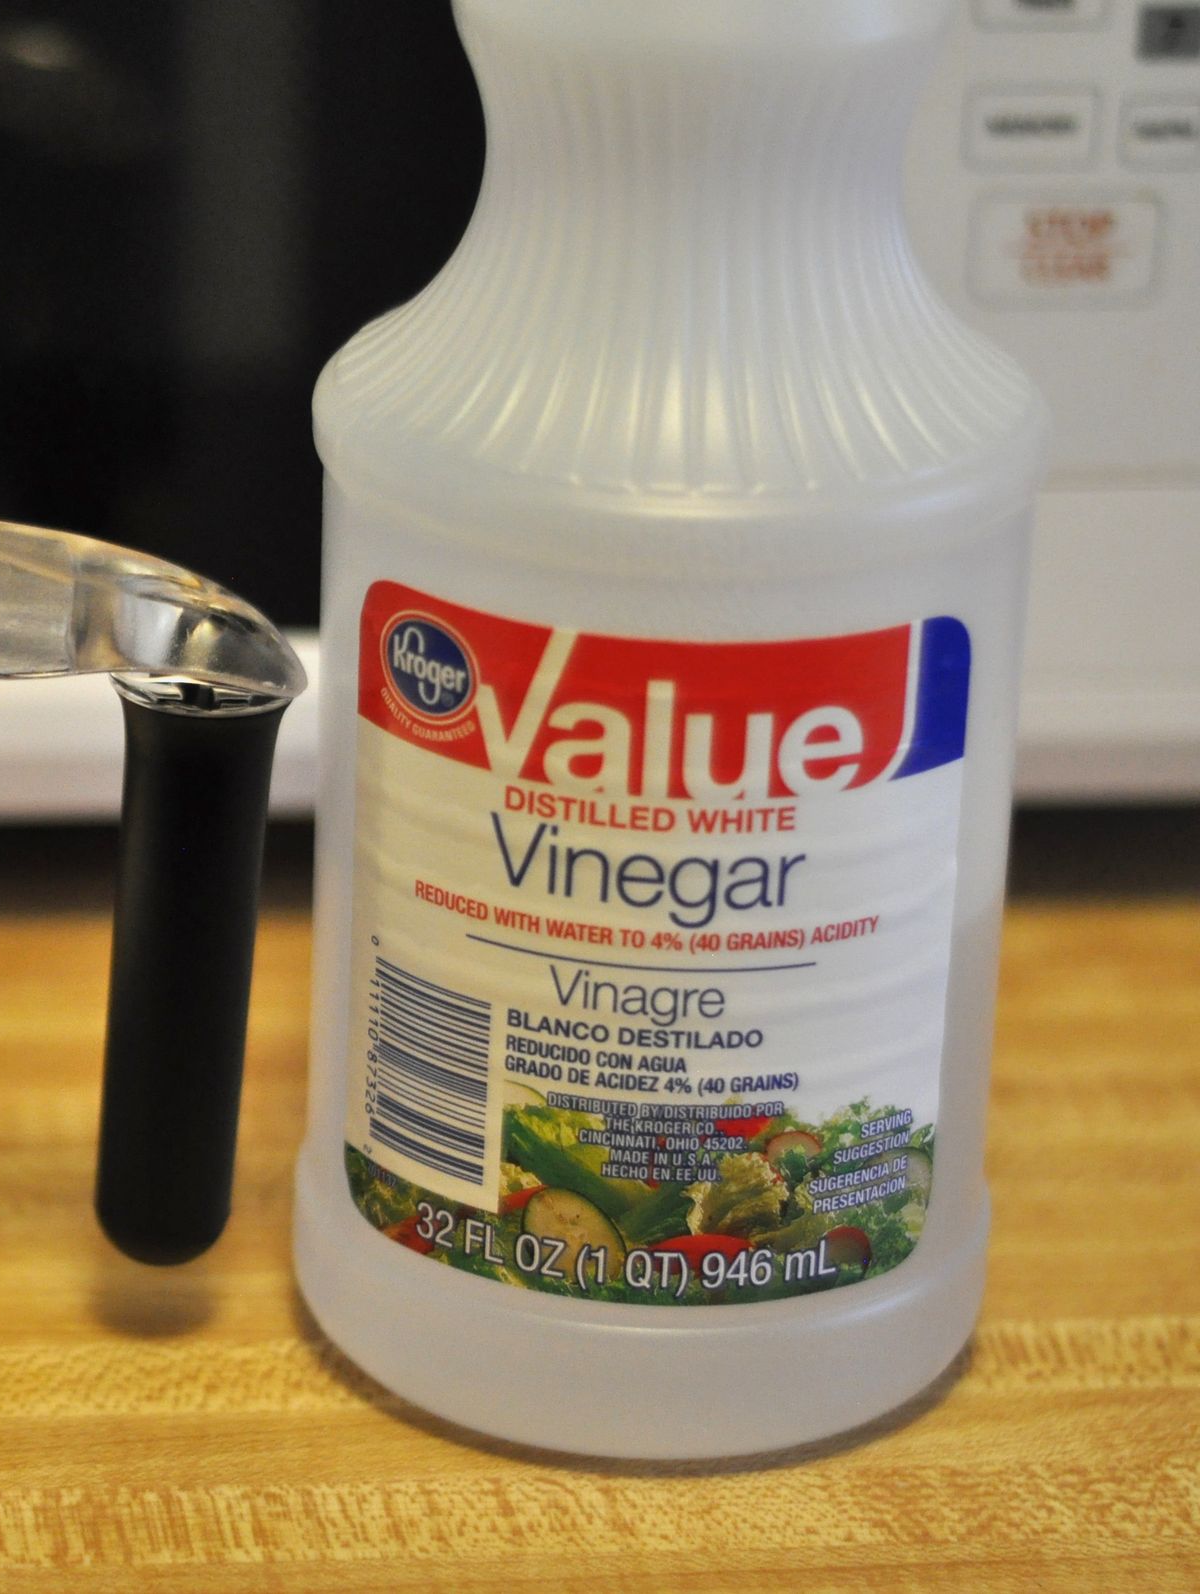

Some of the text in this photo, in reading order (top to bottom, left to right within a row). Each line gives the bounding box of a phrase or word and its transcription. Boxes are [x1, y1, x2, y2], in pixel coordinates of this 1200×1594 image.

[393, 627, 466, 705] Kroger
[380, 687, 476, 741] QUALITY GUARANTEED
[473, 627, 863, 800] Value
[503, 785, 796, 834] DISTILLED WHITE
[490, 811, 806, 929] Vinegar
[415, 879, 880, 955] REDUCED WITH WATER TO 4% (40 GRAINS) ACIDITY
[550, 965, 725, 1027] Vinagre
[507, 1008, 763, 1050] BLANCO DESTILADO
[506, 1034, 687, 1073] REDUCIDO CON AGUA
[505, 1056, 799, 1097] GRADO DE ACIDEZ 4% (40 GRAINS)
[548, 1093, 636, 1117] DISTRIBUTED
[755, 1101, 784, 1117] POR
[861, 1110, 912, 1138] SERVING
[579, 1130, 661, 1150] CINCINNATI,
[666, 1137, 700, 1150] OHIO
[605, 1118, 629, 1132] THE
[635, 1120, 691, 1135] KROGER
[611, 1149, 649, 1164] MADE
[654, 1152, 667, 1165] IN
[833, 1131, 910, 1165] SUGGESTION
[602, 1164, 648, 1179] HECHO
[809, 1155, 908, 1194] SUGERENCIA DE
[813, 1176, 905, 1213] PRESENTACION
[416, 1201, 837, 1296] 32 FL OZ (1 QT) 946 mL
